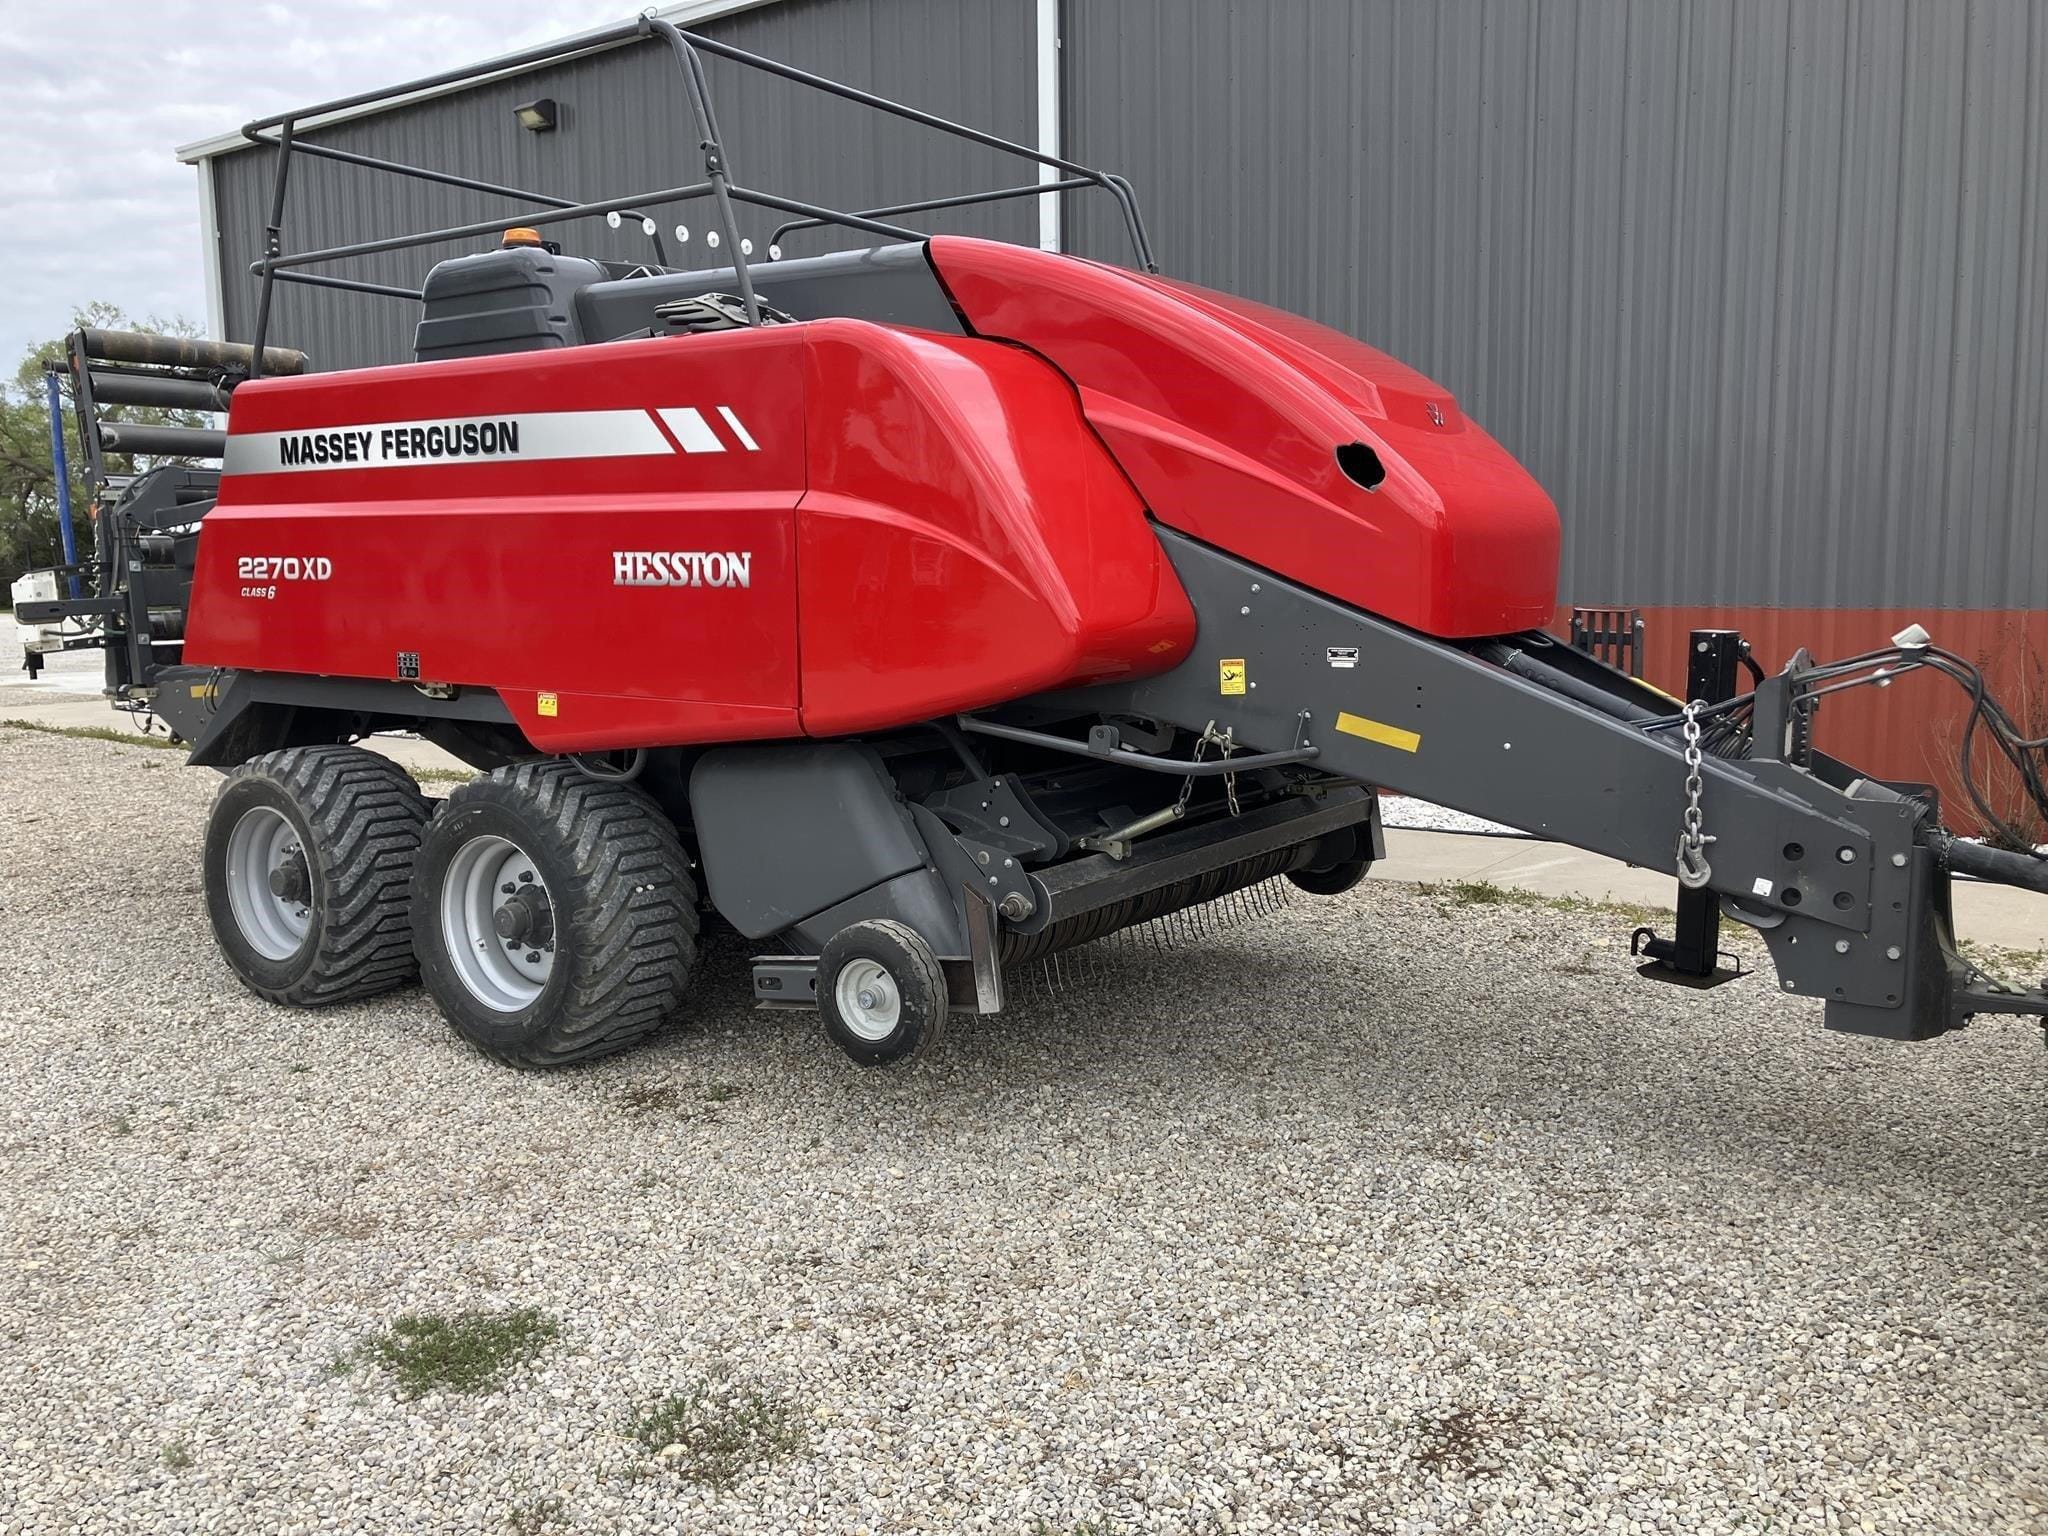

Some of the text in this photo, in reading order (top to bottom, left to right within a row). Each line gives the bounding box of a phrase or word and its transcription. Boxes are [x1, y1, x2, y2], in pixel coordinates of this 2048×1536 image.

[279, 421, 519, 466] MASSEY FERGUSON
[613, 551, 752, 588] HESSTON
